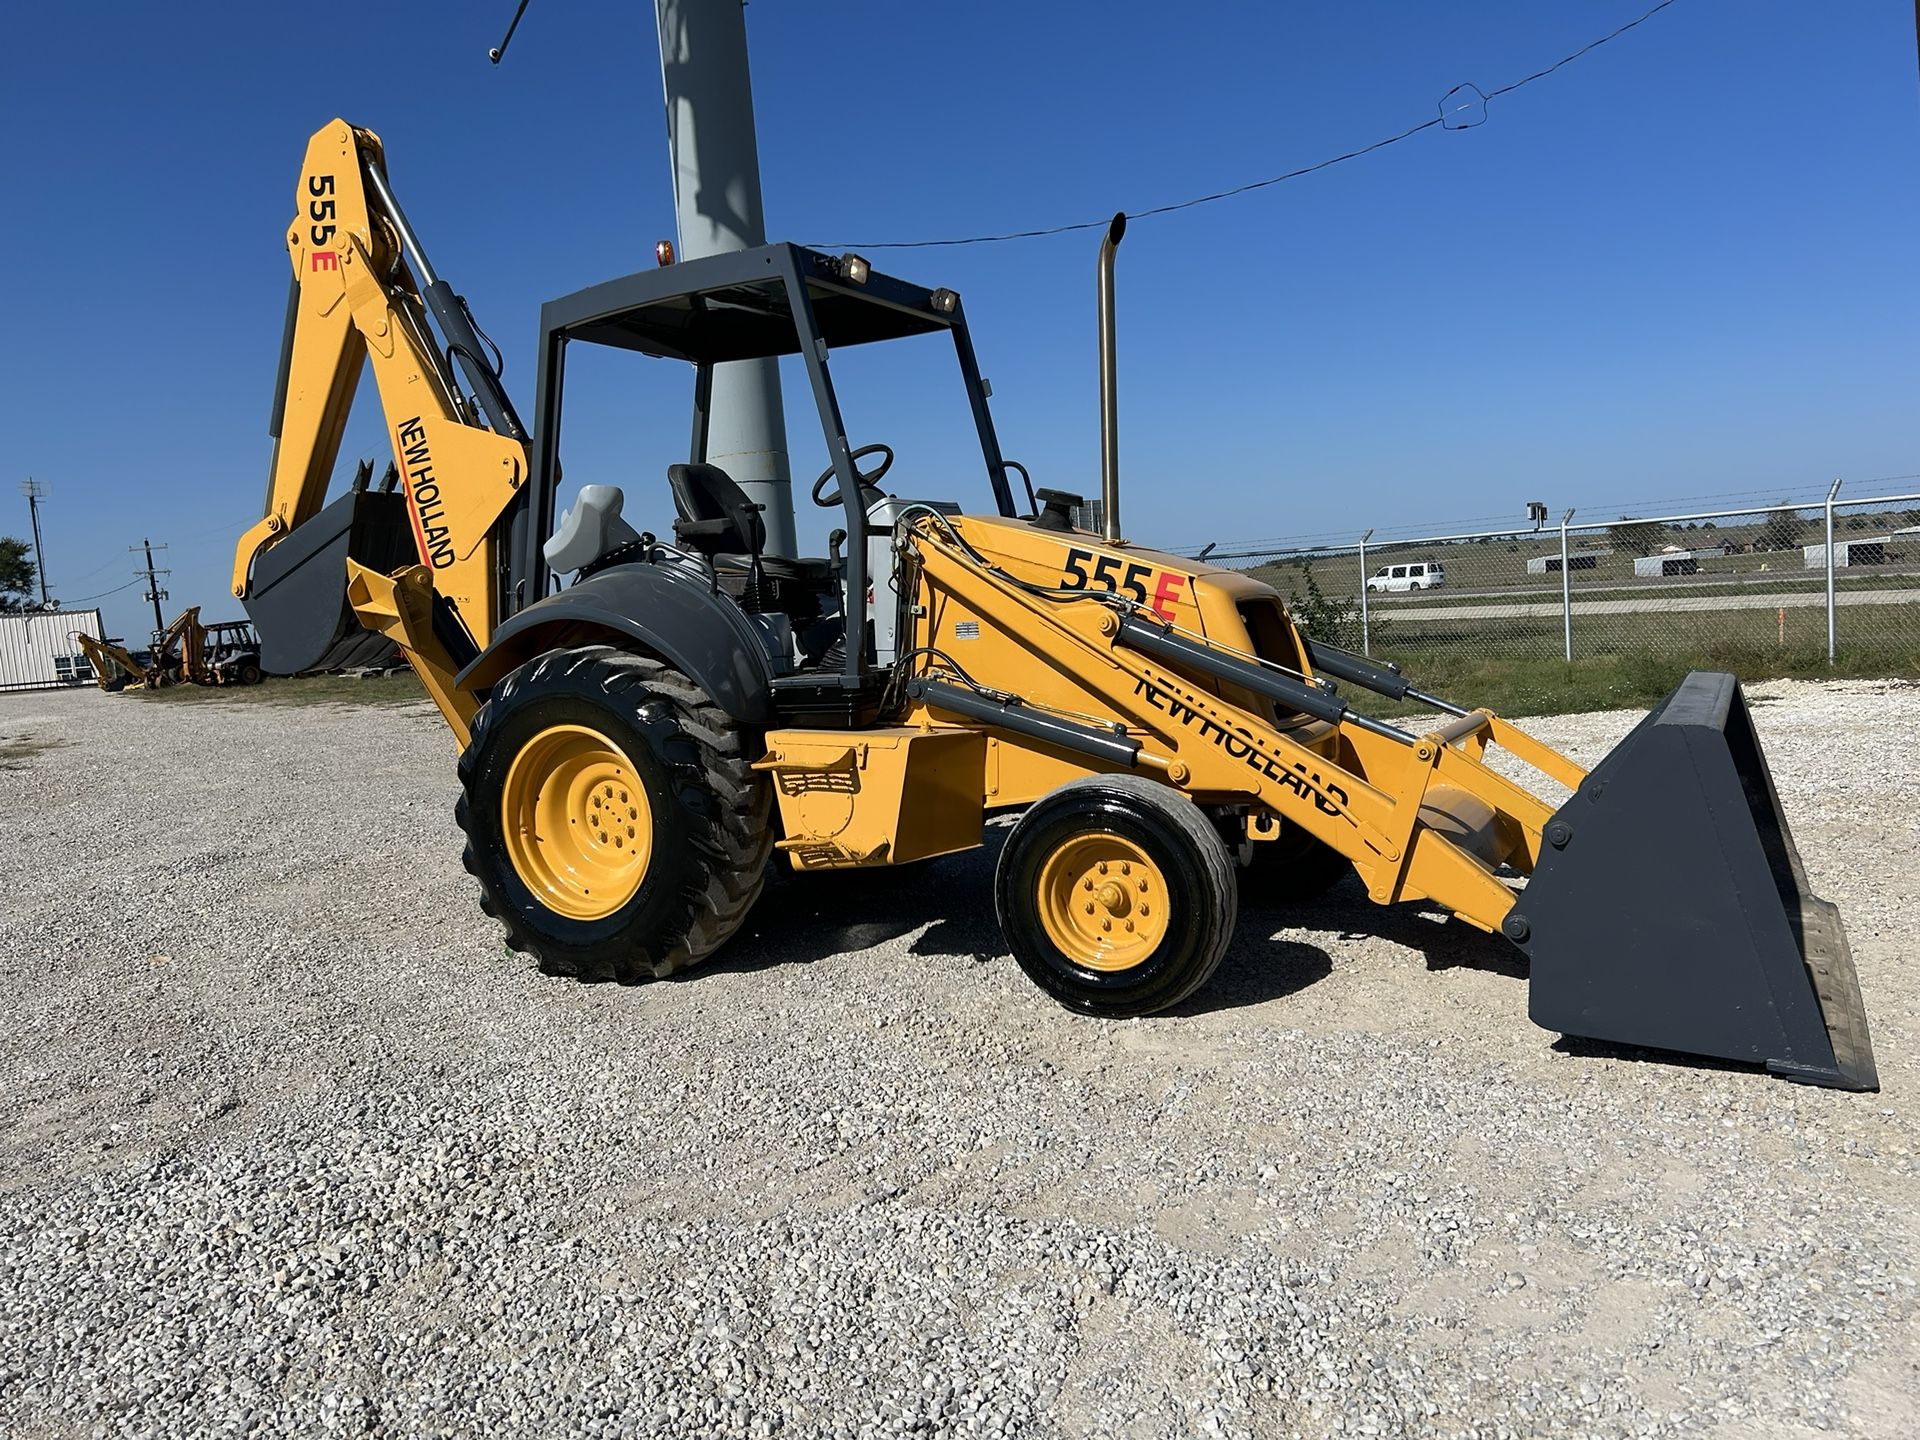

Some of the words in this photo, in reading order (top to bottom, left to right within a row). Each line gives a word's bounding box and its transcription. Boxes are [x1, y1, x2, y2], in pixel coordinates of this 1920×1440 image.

[309, 175, 337, 272] 555E
[398, 416, 431, 466] NEW
[410, 465, 456, 569] HOLLAND
[1060, 548, 1186, 622] 555E
[1134, 669, 1206, 726] NEW
[1199, 711, 1349, 817] HOLLAND
